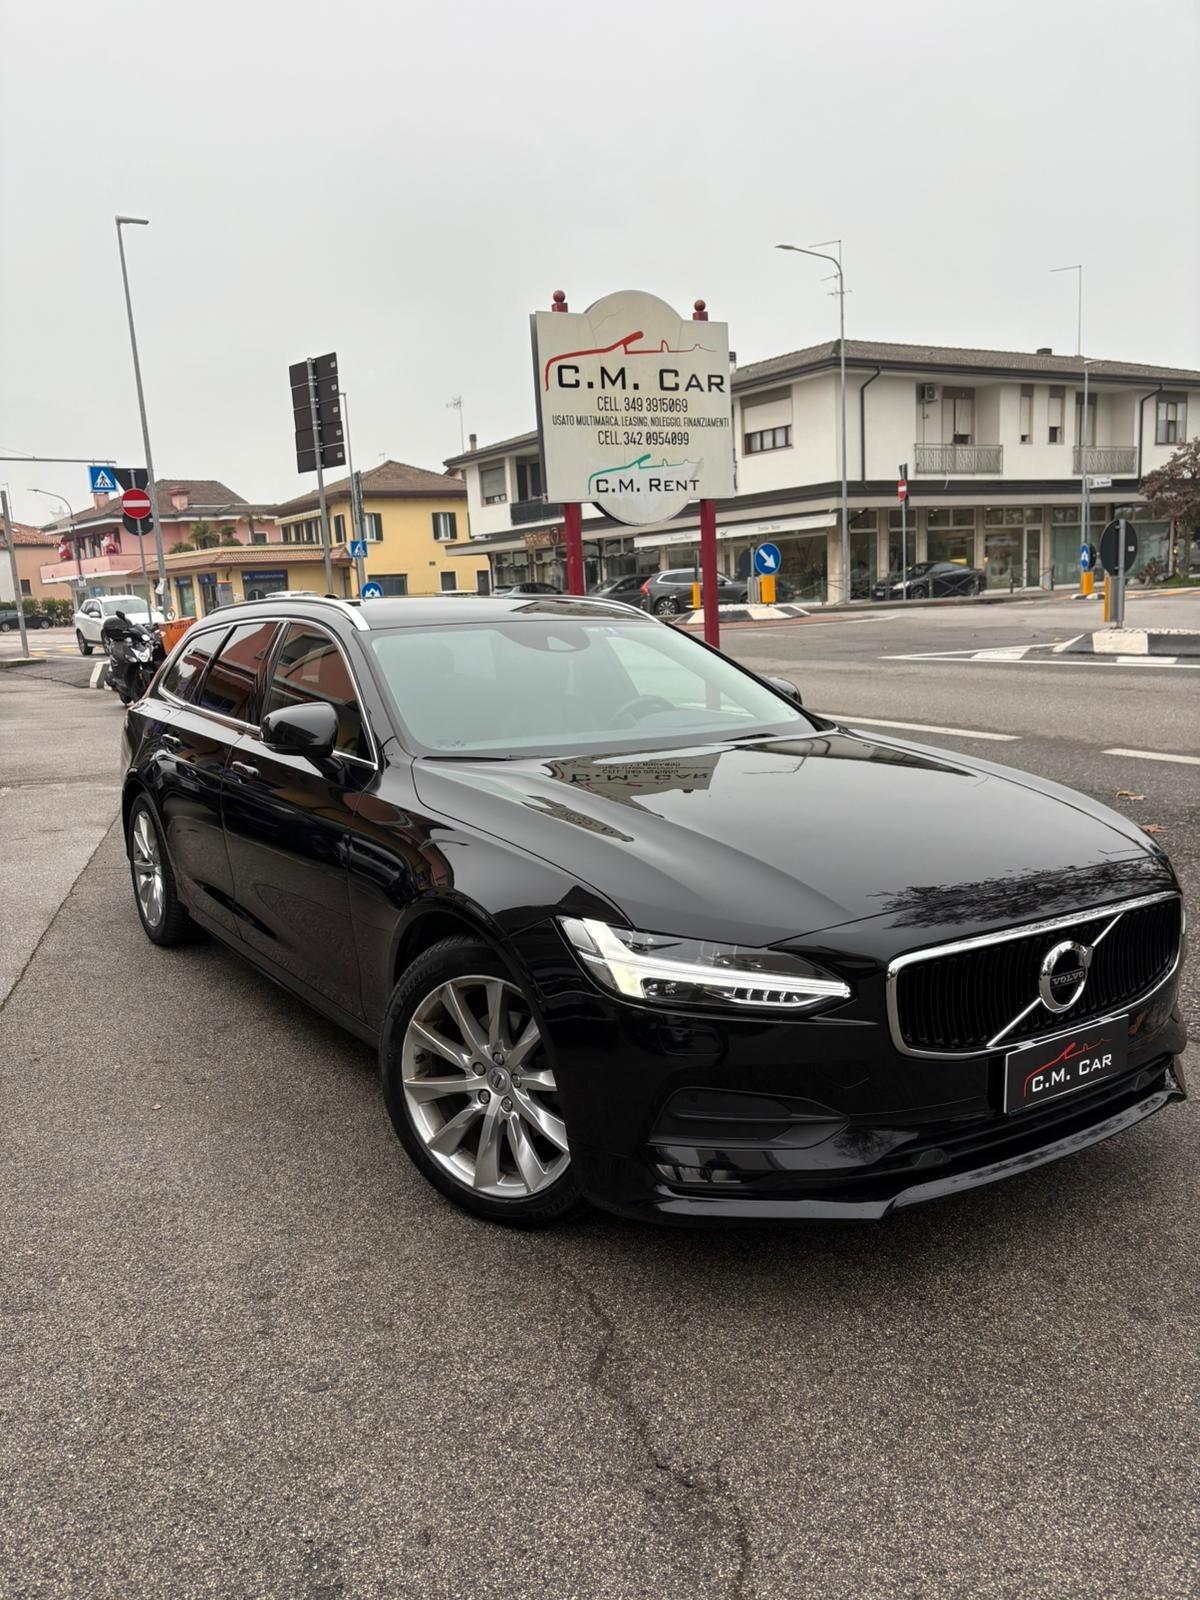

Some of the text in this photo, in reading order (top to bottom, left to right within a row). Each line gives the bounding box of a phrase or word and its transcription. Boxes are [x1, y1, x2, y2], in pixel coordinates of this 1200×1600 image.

[557, 364, 726, 393] C.M. CAR
[597, 396, 688, 413] CELL. 349 3915069
[552, 414, 575, 426] USATO
[683, 416, 729, 428] FINANZIAMENTI
[597, 430, 689, 446] CELL. 342 0954099
[596, 478, 640, 493] C.M.
[1052, 970, 1085, 985] VOLVO
[1032, 1054, 1112, 1093] C.M. CAR
